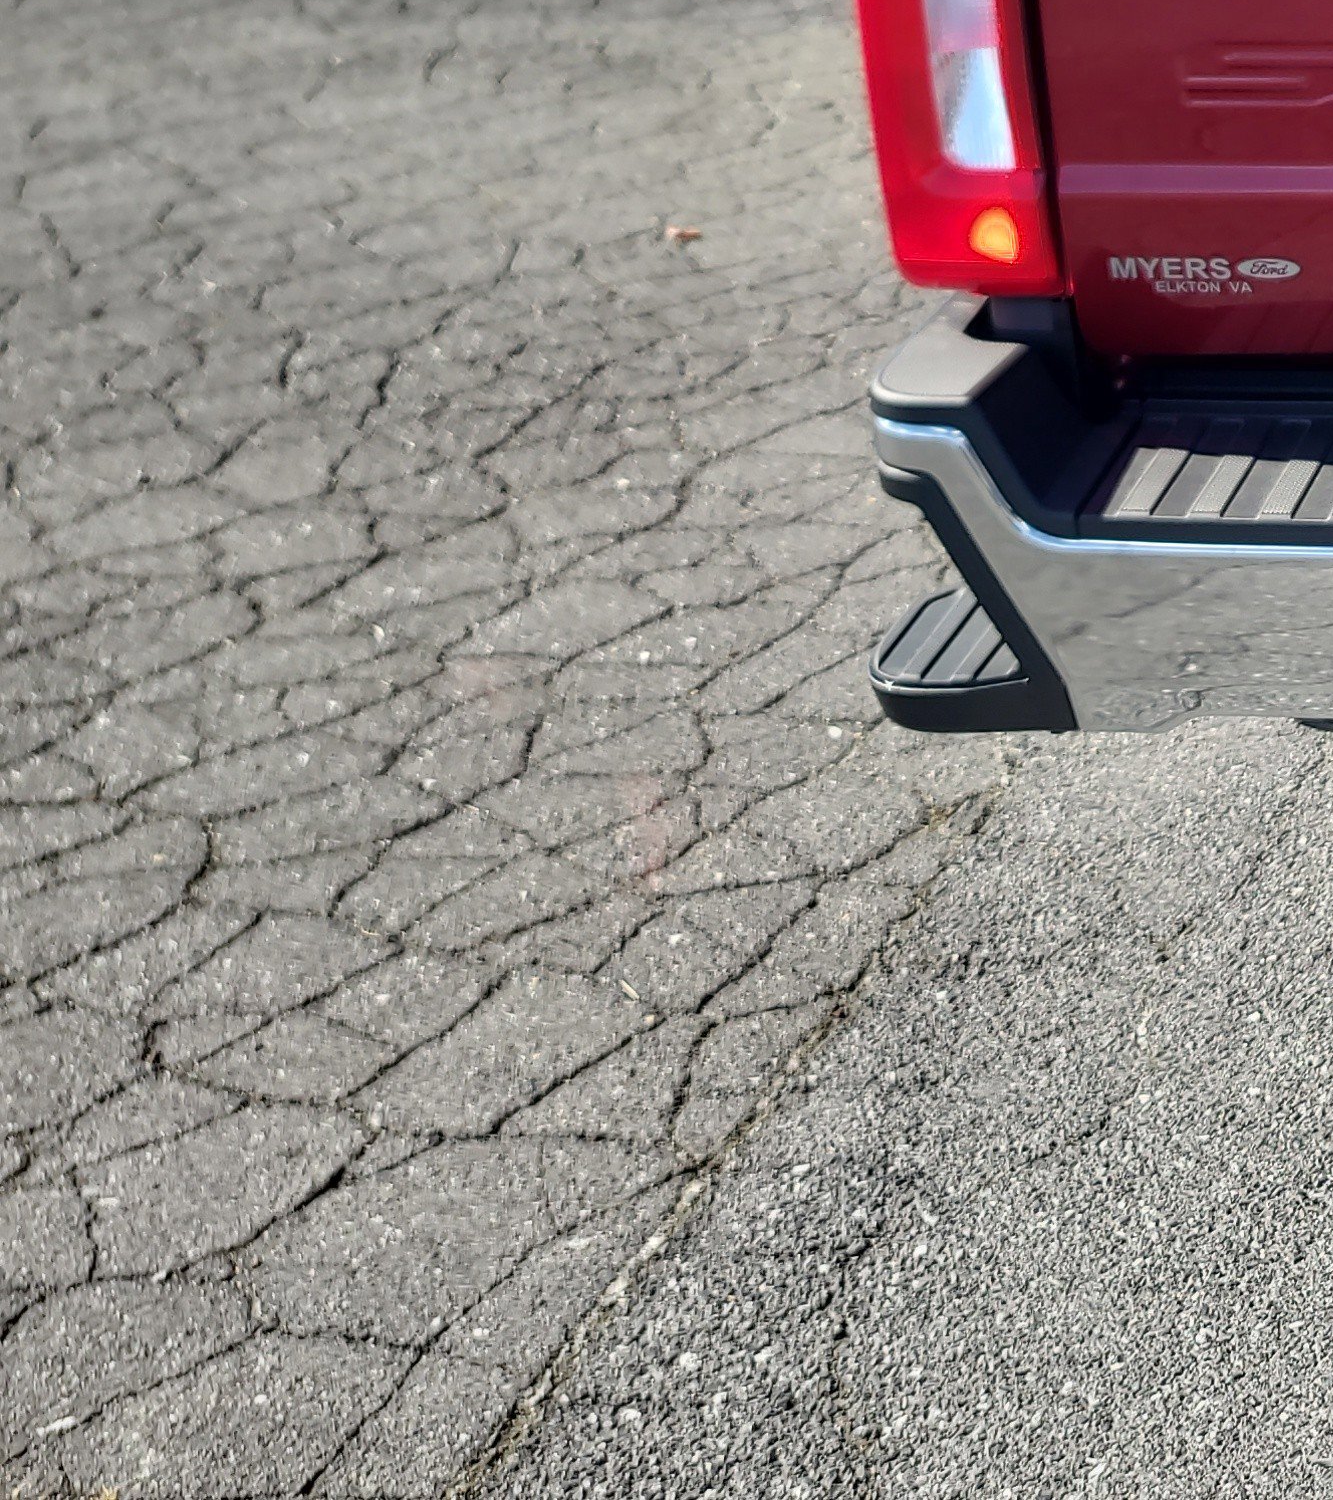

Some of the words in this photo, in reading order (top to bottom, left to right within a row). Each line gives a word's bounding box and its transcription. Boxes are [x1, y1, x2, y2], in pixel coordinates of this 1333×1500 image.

[1108, 257, 1232, 279] MYERS
[1155, 280, 1221, 294] ELKTON
[1229, 280, 1253, 294] VA
